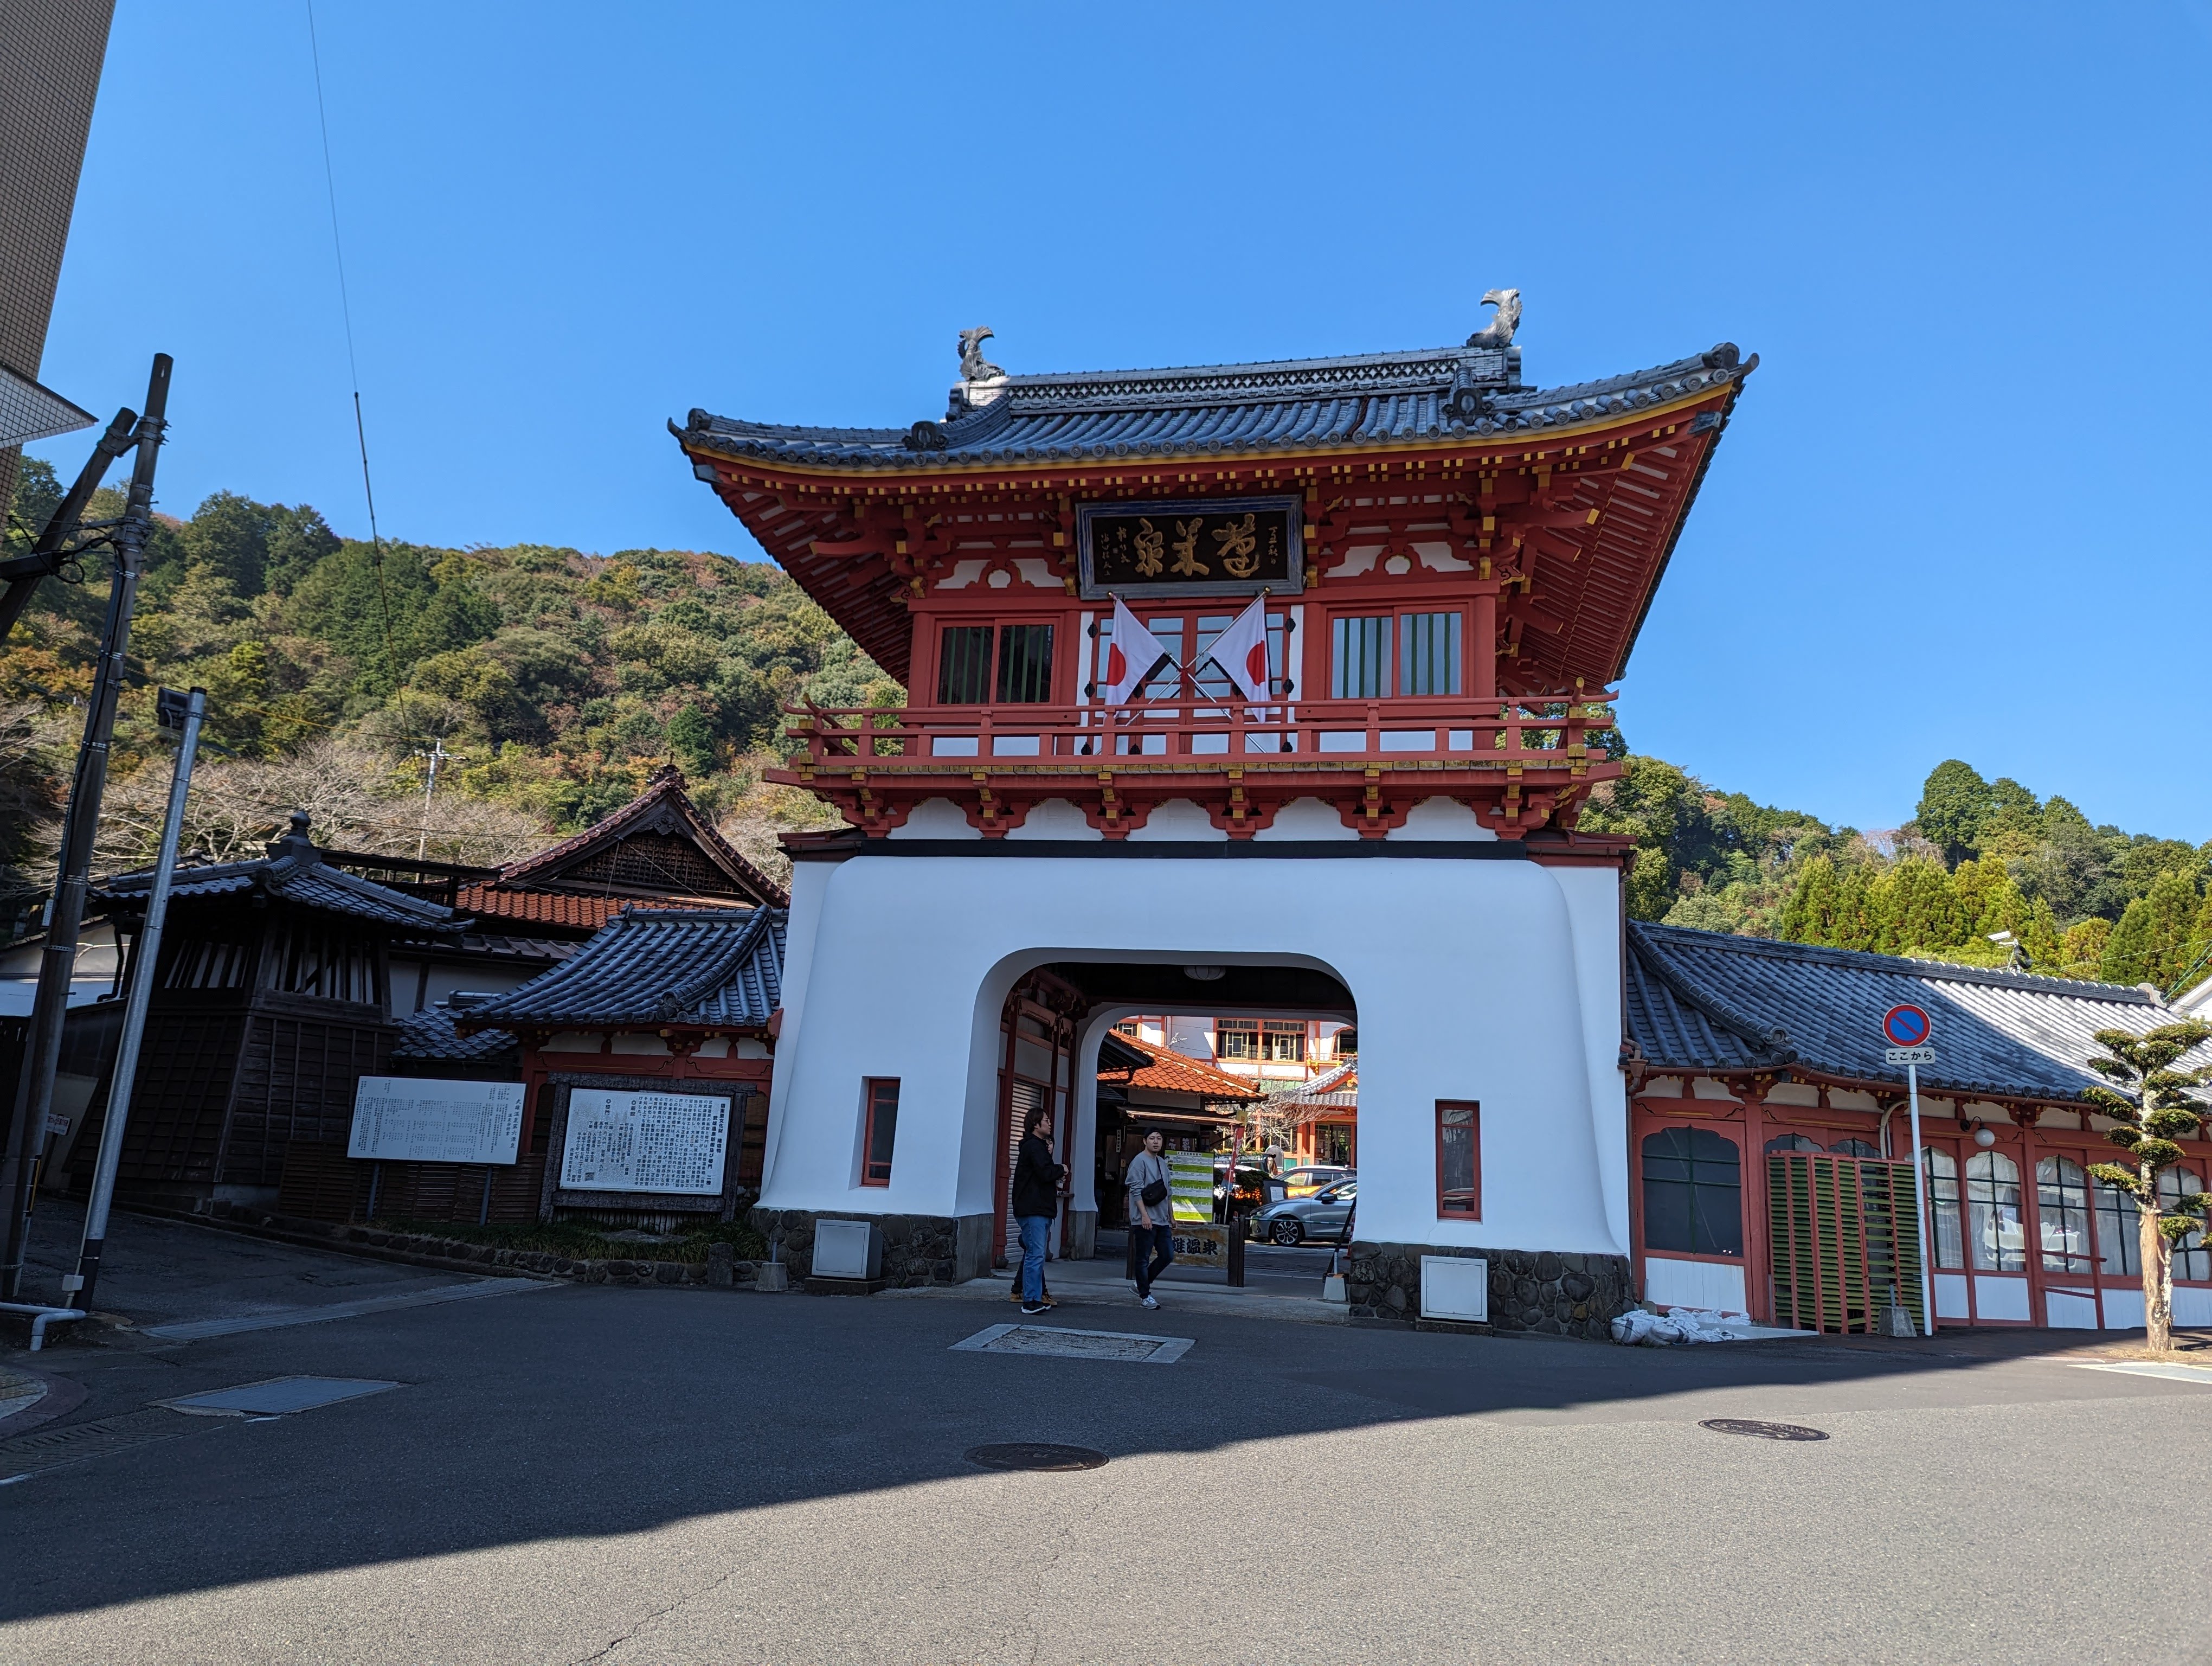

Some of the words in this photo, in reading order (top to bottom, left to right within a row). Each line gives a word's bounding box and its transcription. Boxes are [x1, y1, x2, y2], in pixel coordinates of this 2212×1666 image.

[1888, 1051, 1932, 1061] ここから
[1172, 1236, 1218, 1255] 雄温泉
